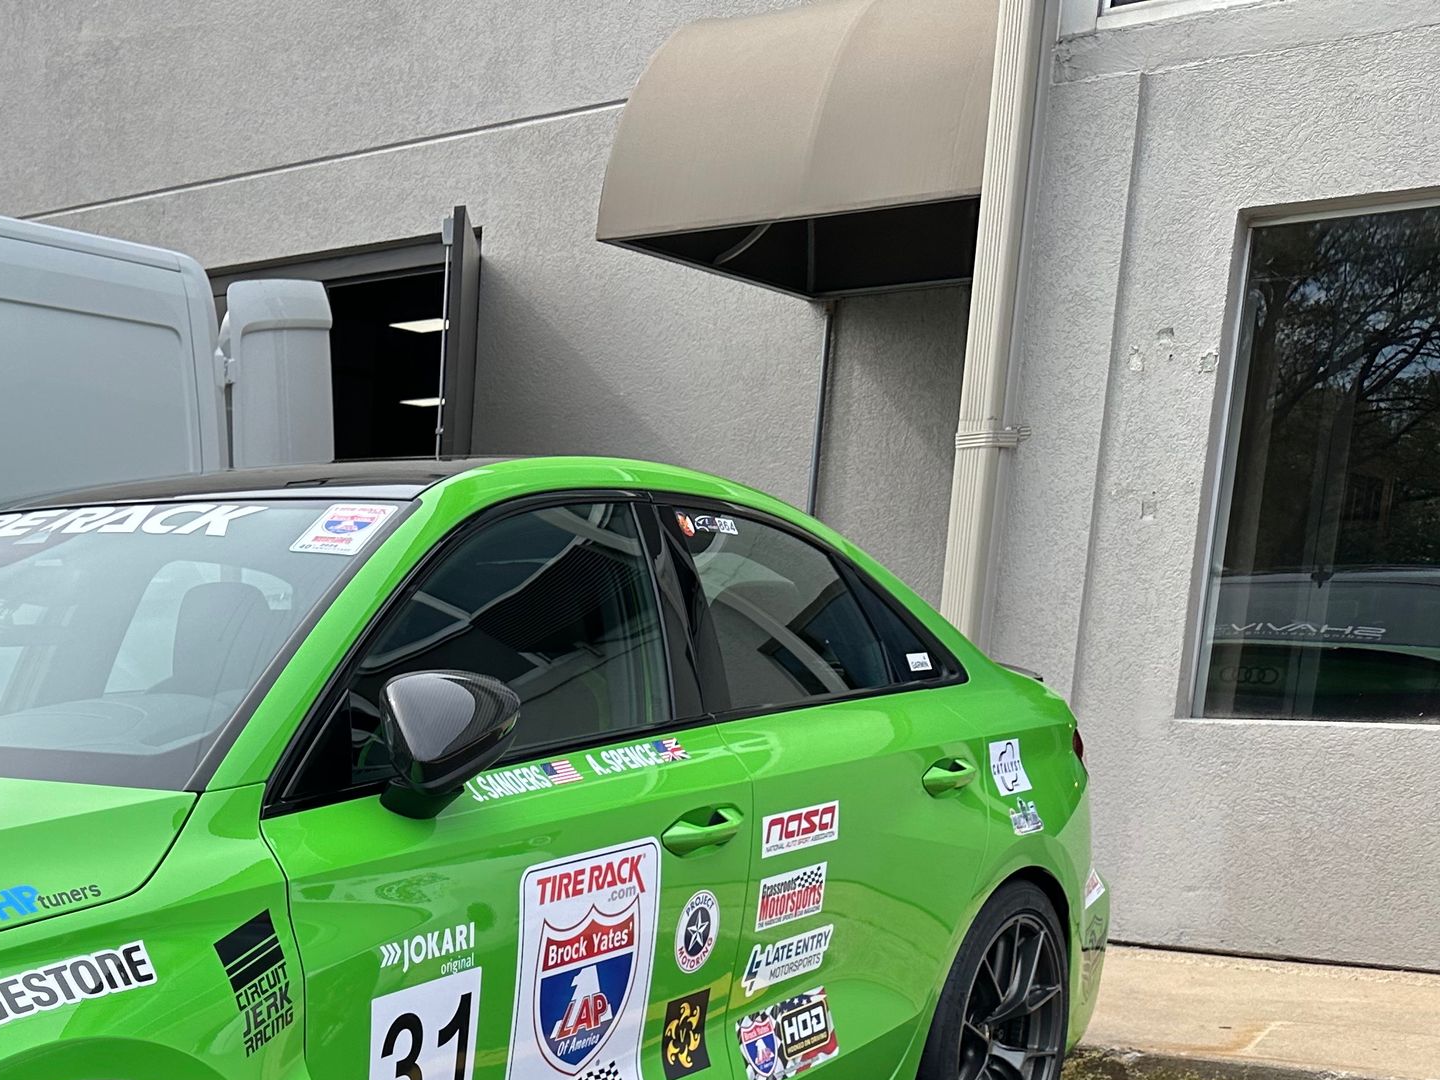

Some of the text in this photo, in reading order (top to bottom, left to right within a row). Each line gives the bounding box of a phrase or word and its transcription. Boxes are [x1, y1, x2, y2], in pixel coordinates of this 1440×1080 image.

[46, 504, 270, 537] RACK
[992, 760, 1020, 775] CATALYST
[537, 854, 646, 906] TIRE RACK
[608, 885, 636, 902] .com
[762, 877, 797, 897] Grassroots
[685, 894, 715, 917] PROJECT
[759, 883, 823, 921] Motorsports
[402, 921, 475, 974] JOKARI
[547, 921, 633, 967] Brock Yates'
[678, 936, 713, 971] MOTORING
[765, 929, 831, 967] LATE ENTRY
[440, 952, 475, 976] original
[768, 953, 821, 981] MOTORSPORTS
[235, 961, 288, 1012] CIRCUIT
[243, 981, 293, 1038] JERK
[554, 992, 608, 1041] LAP
[244, 1005, 294, 1058] RACING
[568, 1033, 600, 1054] America
